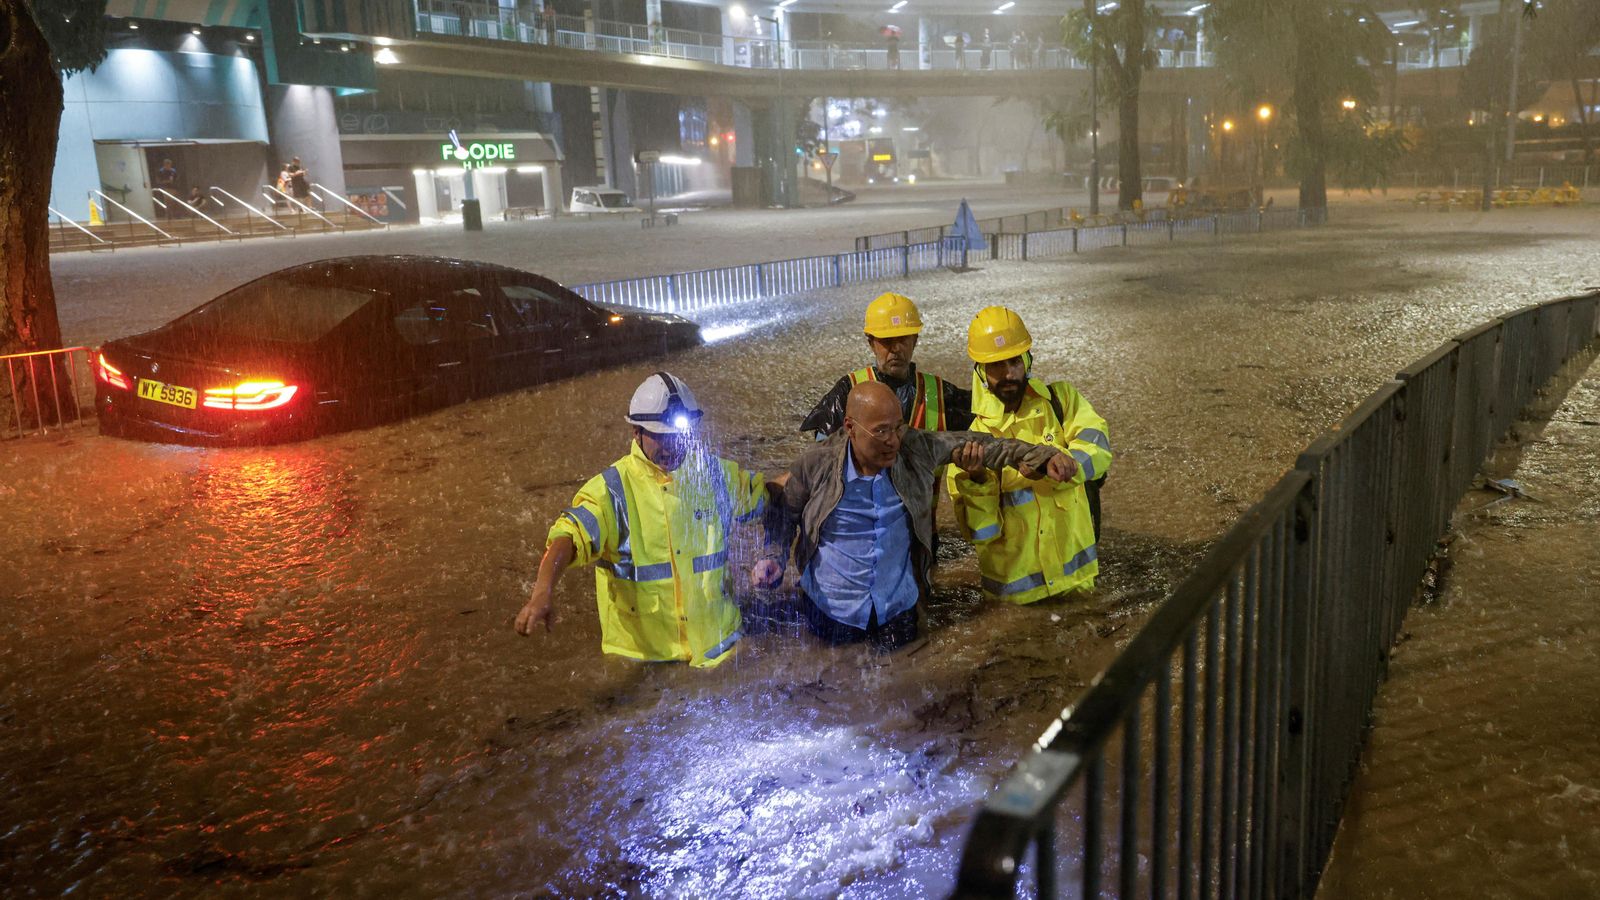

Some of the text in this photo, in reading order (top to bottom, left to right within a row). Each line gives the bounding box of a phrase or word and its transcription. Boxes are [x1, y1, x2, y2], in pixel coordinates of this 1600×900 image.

[442, 143, 515, 160] FOODIE
[463, 161, 493, 170] HU
[142, 382, 192, 405] WY 5936
